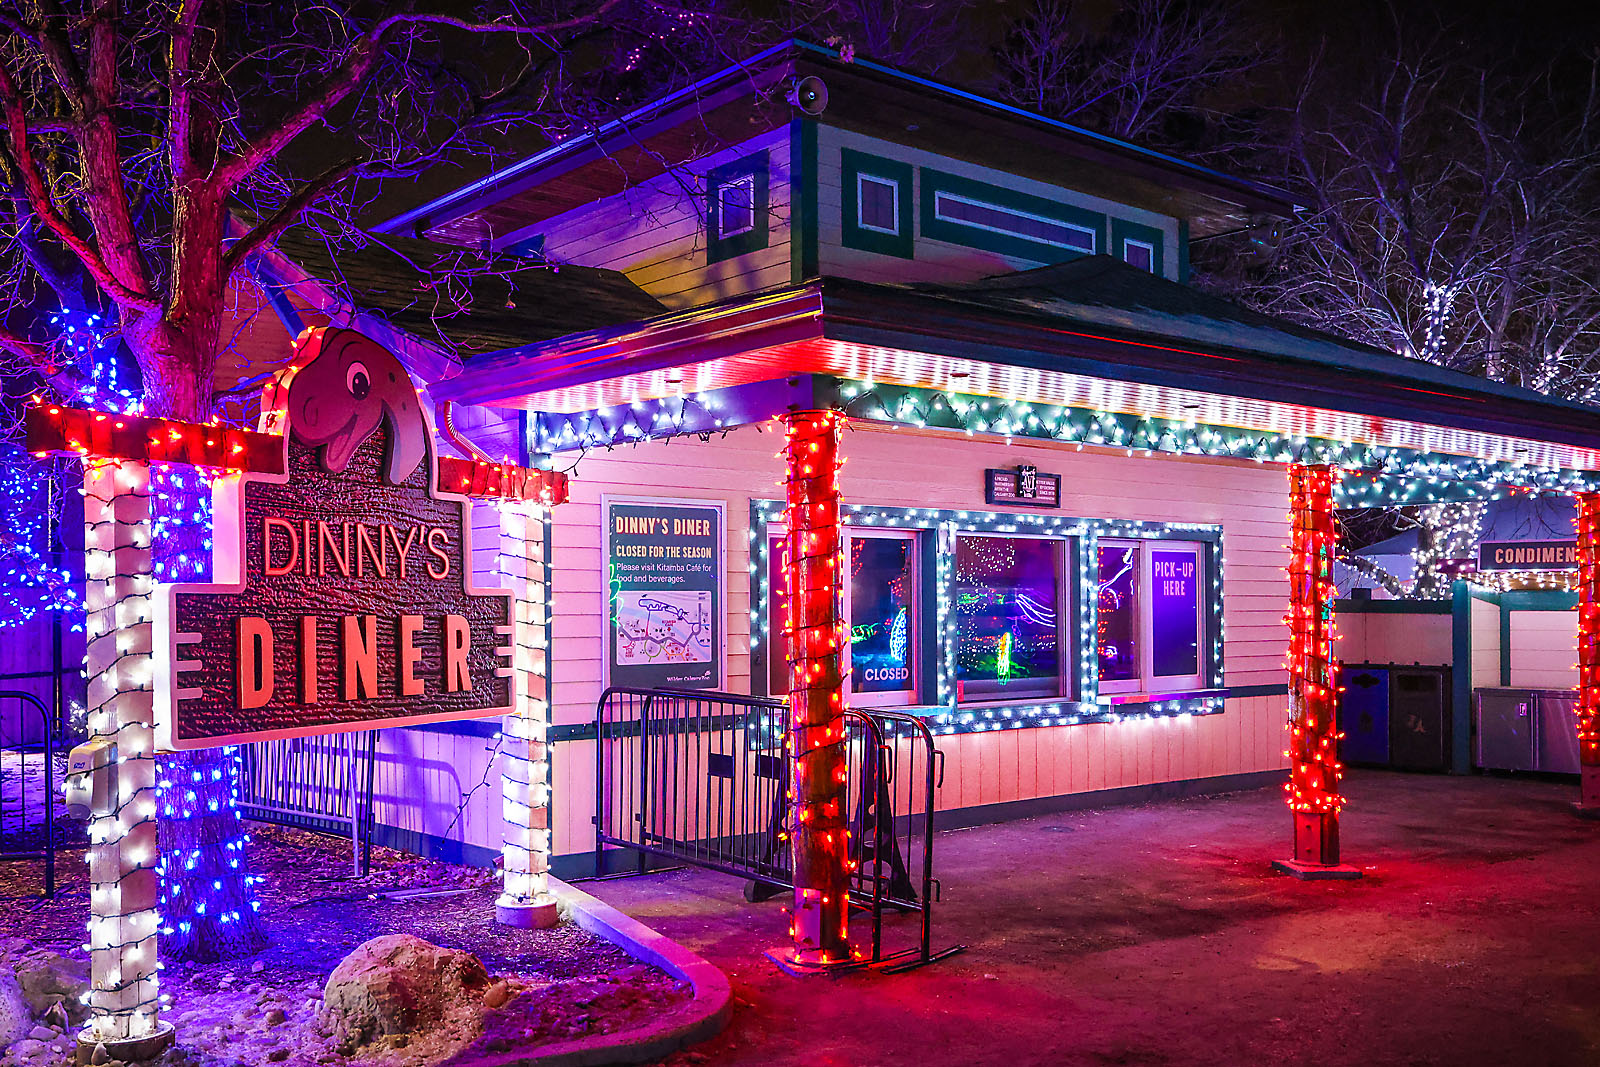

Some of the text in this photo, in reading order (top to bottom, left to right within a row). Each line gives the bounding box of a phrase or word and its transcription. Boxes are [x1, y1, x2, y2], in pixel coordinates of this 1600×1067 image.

[615, 516, 711, 536] DINNY'S DINER
[264, 517, 450, 581] DINNY'S
[616, 545, 712, 559] CLOSED FOR THE SEASON
[1495, 546, 1576, 564] CONDIMEN
[616, 562, 712, 572] Please visit Kitamba Café for
[1154, 561, 1194, 578] PICK-UP
[616, 574, 686, 584] food and beverages.
[1163, 580, 1186, 596] HERE
[235, 614, 473, 710] DINER
[864, 667, 909, 681] CLOSED
